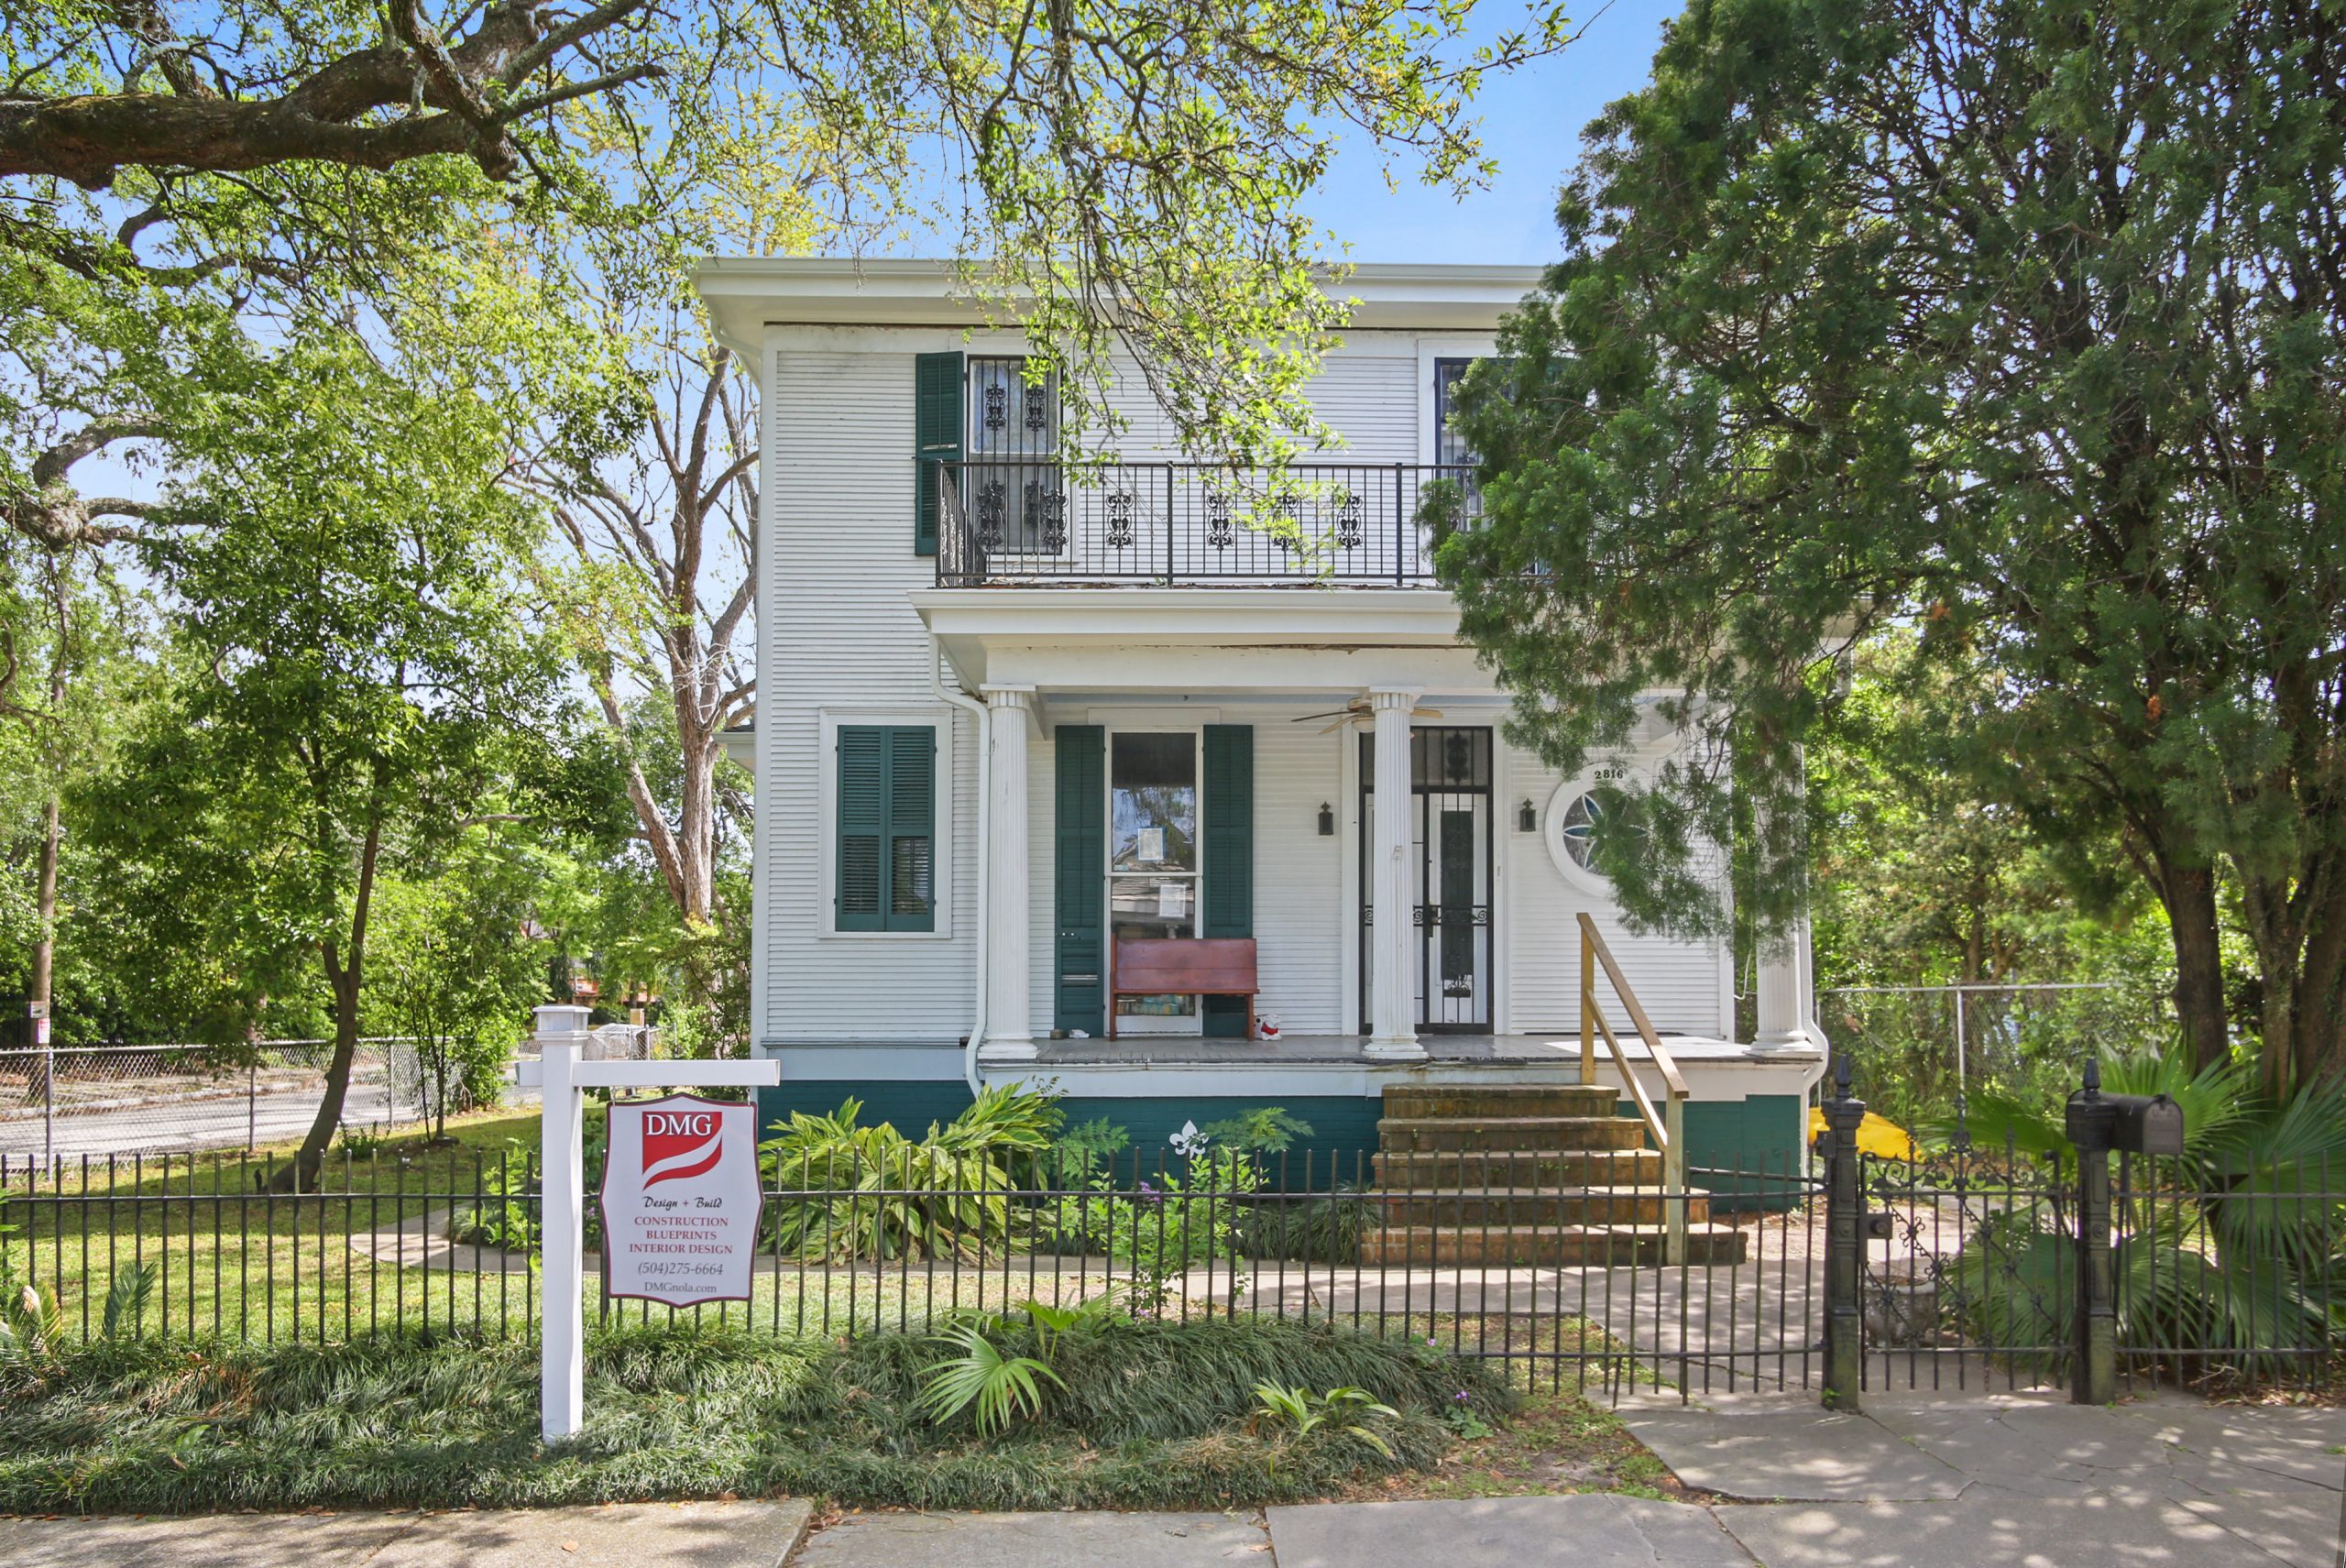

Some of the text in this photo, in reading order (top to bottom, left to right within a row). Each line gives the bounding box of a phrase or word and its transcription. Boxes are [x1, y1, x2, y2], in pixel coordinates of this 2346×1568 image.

[1595, 769, 1624, 779] 2816
[646, 1113, 713, 1136] DMG
[642, 1196, 678, 1211] Design
[694, 1196, 723, 1209] Build
[634, 1216, 729, 1227] CONSTRUCTION
[646, 1230, 718, 1240] BLUEPRINTS
[630, 1243, 733, 1255] INTERIOR DESIGN
[638, 1261, 724, 1276] (504)275-6664
[644, 1282, 718, 1293] DMGnola.com
